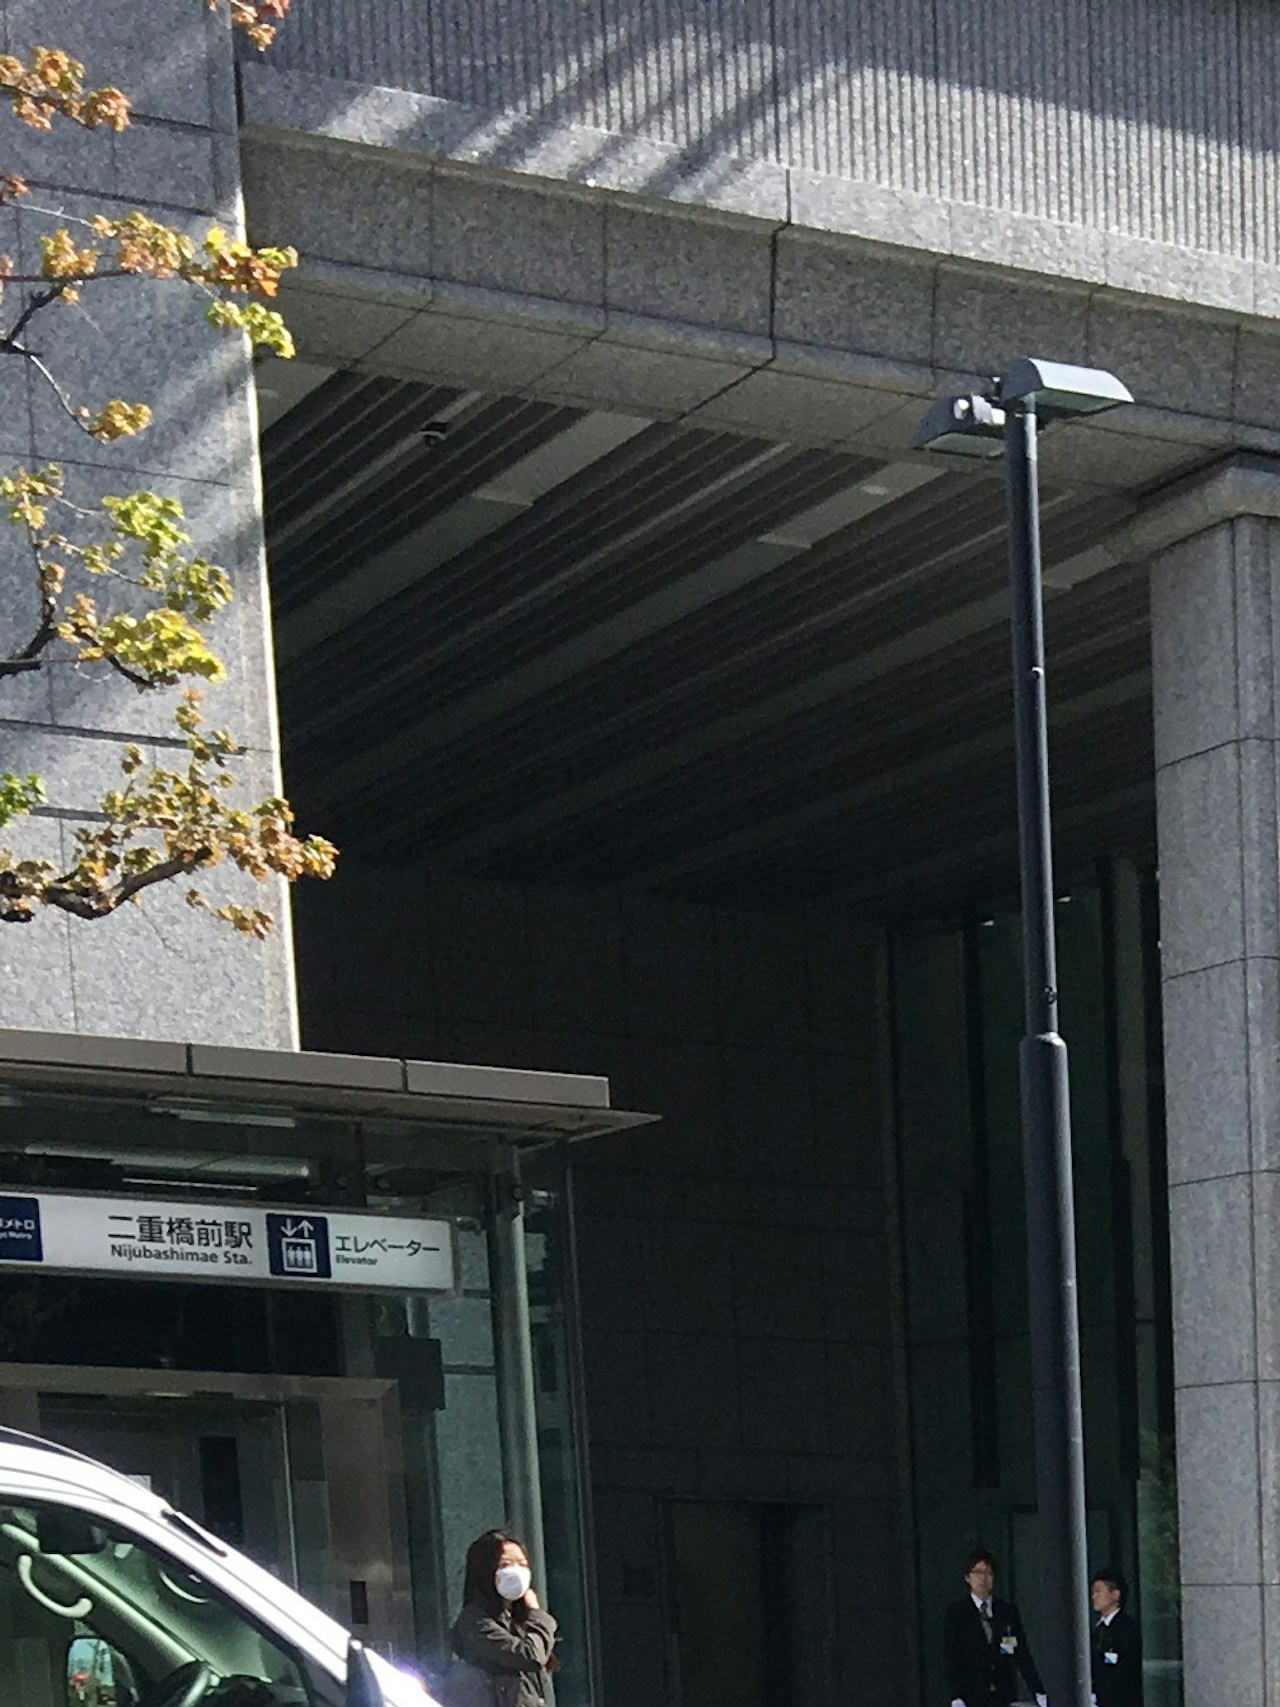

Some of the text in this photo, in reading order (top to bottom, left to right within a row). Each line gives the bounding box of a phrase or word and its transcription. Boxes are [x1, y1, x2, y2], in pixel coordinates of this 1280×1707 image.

[108, 1215, 253, 1249] 二重橋前駅
[110, 1244, 252, 1265] Nijubashimae Sta.
[336, 1236, 440, 1257] エレベーター
[336, 1254, 378, 1266] Elevator
